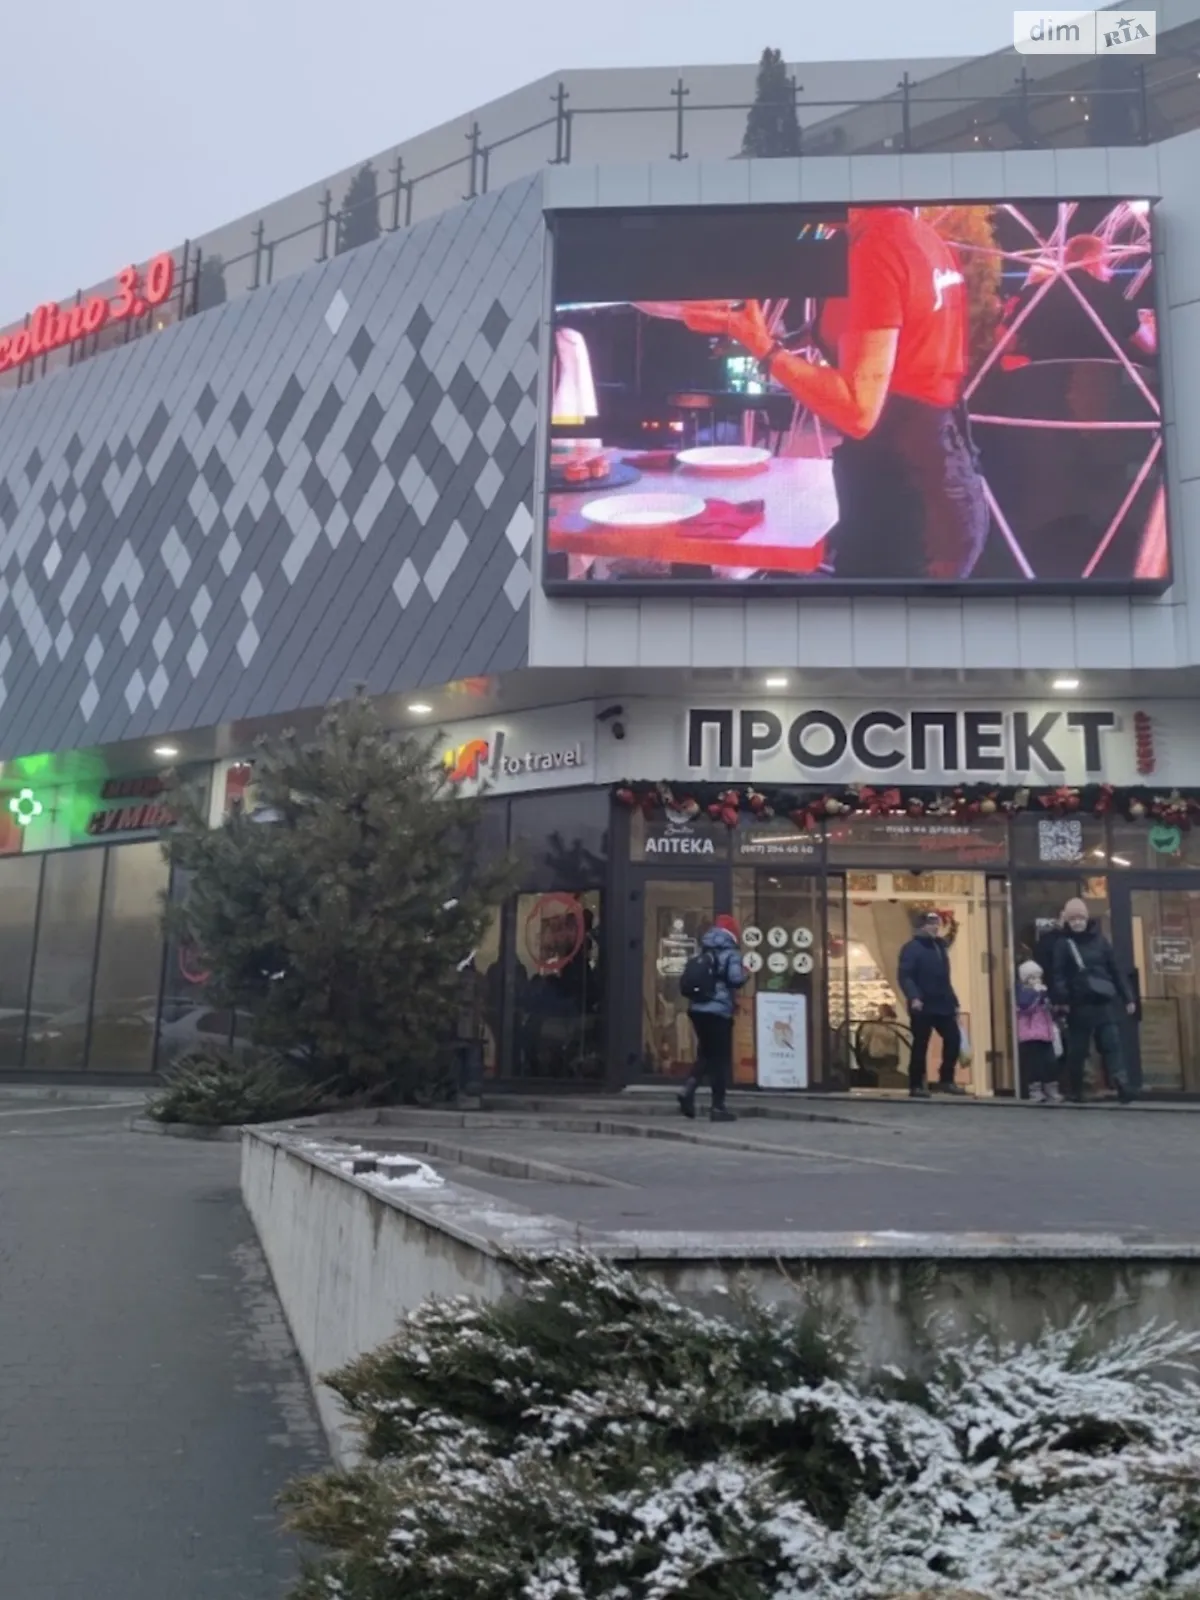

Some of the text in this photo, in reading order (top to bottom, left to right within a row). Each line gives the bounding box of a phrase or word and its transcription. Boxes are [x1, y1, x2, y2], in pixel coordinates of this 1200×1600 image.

[110, 251, 175, 322] 3.0
[500, 756, 519, 774] to
[524, 742, 582, 771] travel
[687, 707, 1115, 773] ПРОСПЕКТ
[645, 838, 714, 854] АПТЕКА
